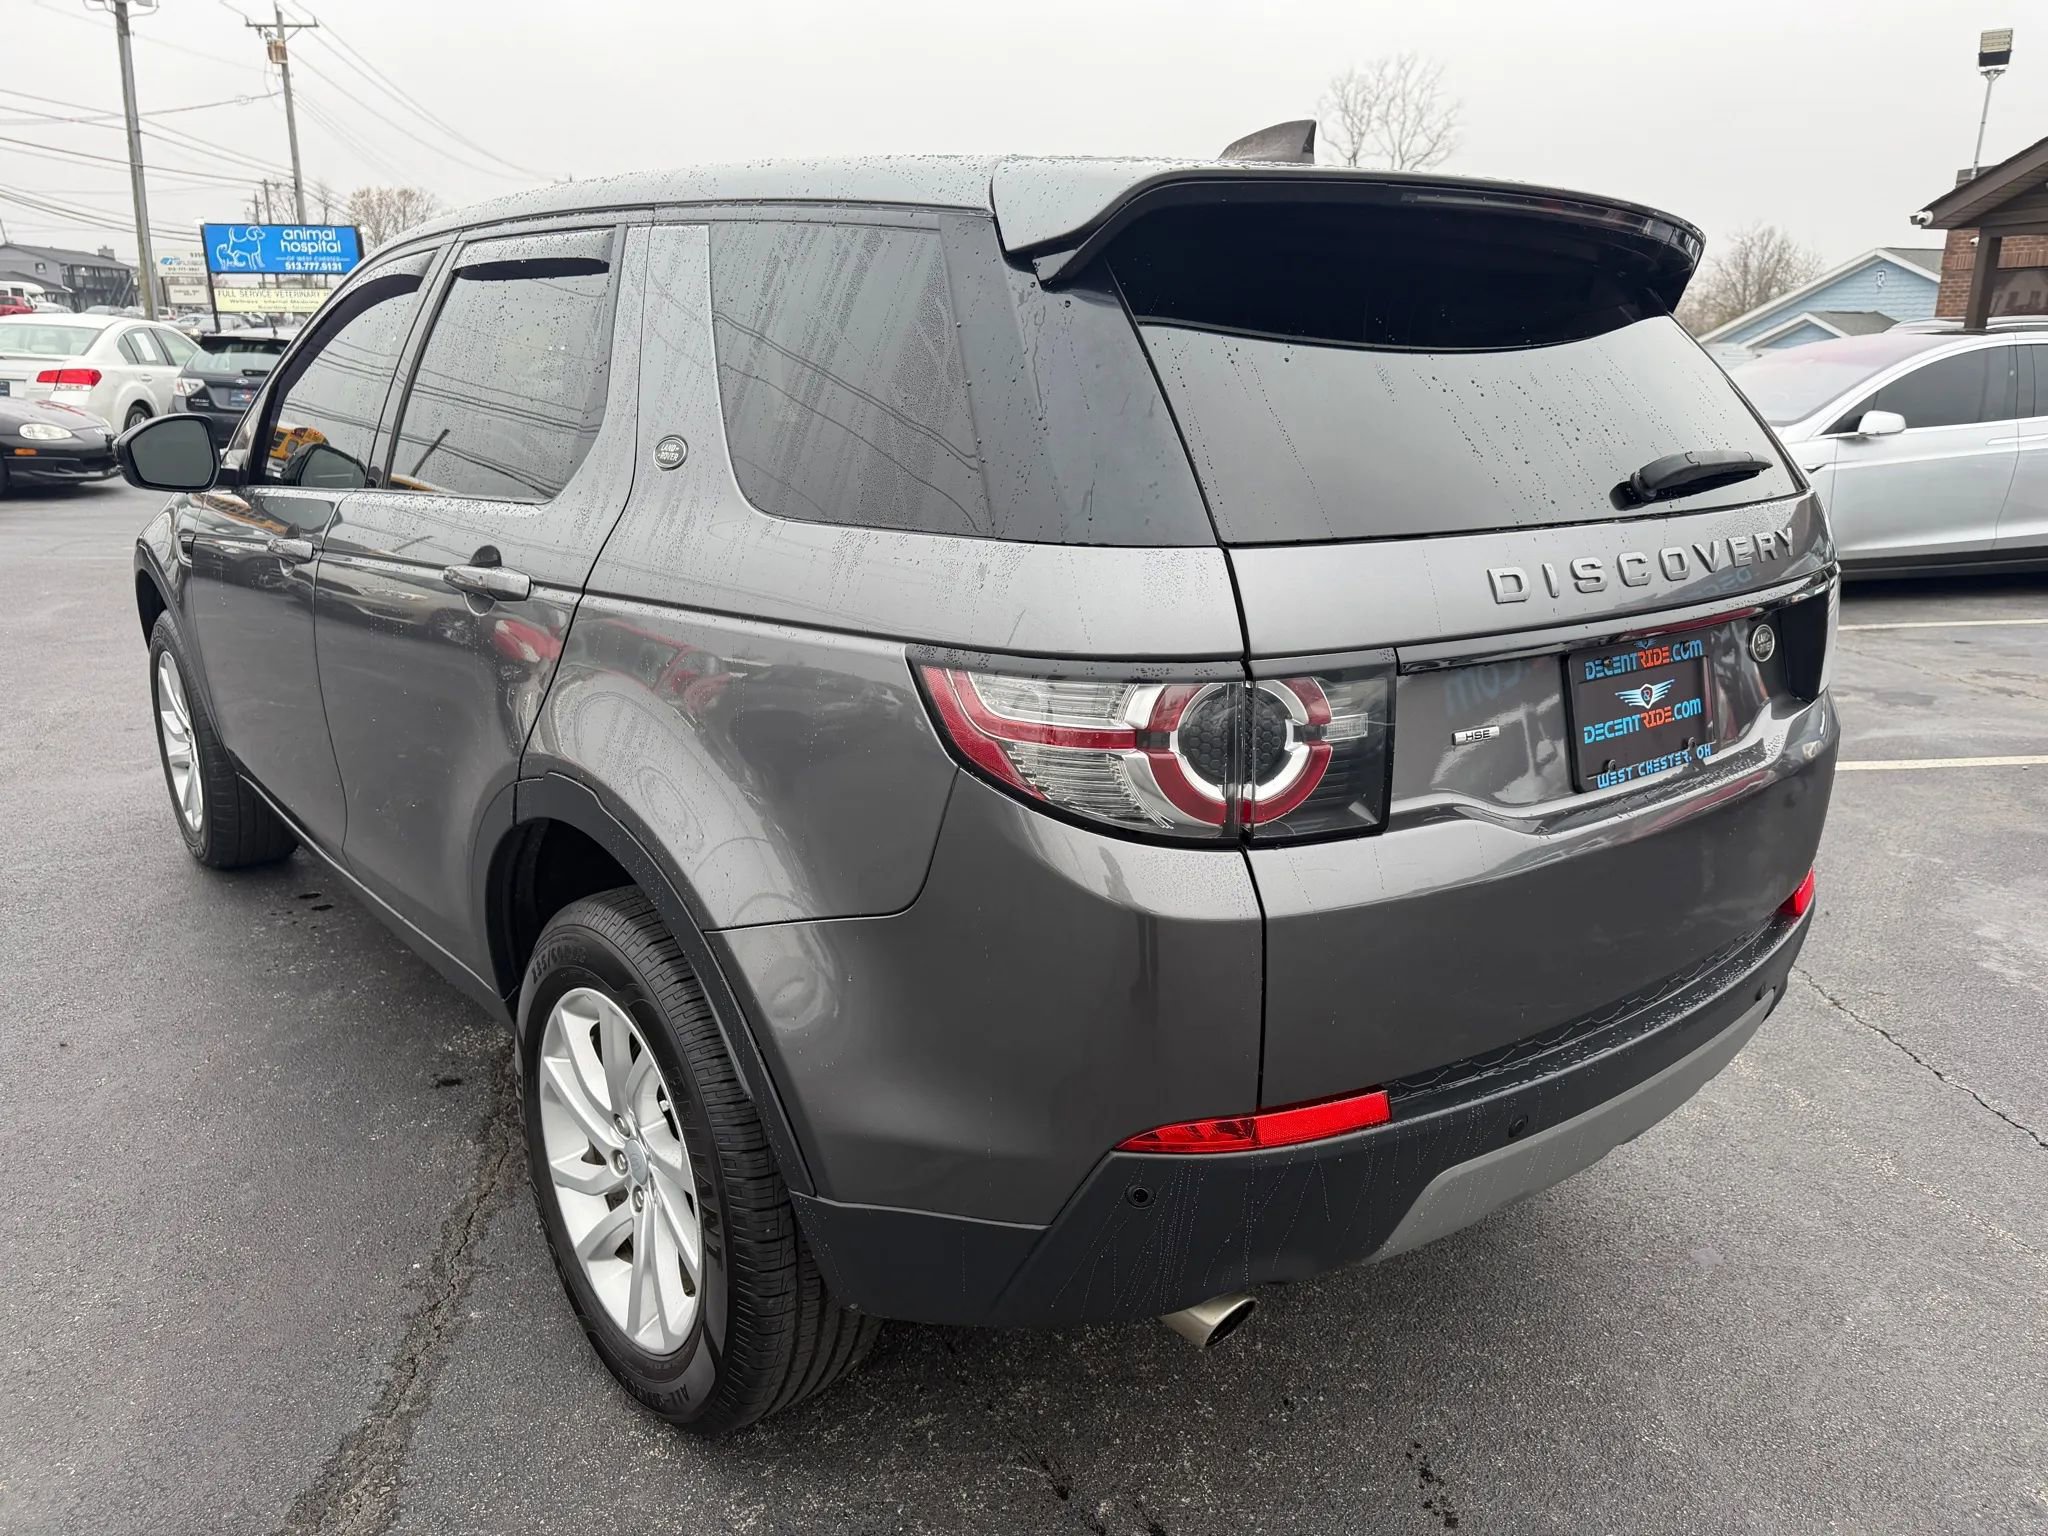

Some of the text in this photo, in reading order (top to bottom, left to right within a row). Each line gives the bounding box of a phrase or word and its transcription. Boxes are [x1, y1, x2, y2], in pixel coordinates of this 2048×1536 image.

[282, 227, 336, 240] animal
[280, 239, 342, 255] hospital
[217, 289, 236, 298] FULL
[239, 289, 272, 298] SERVICE
[275, 289, 320, 298] VETERINARY
[1487, 527, 1794, 604] DISCOVERY
[1465, 729, 1491, 741] HSE
[1597, 766, 1633, 789] WEST
[1696, 743, 1712, 759] OH
